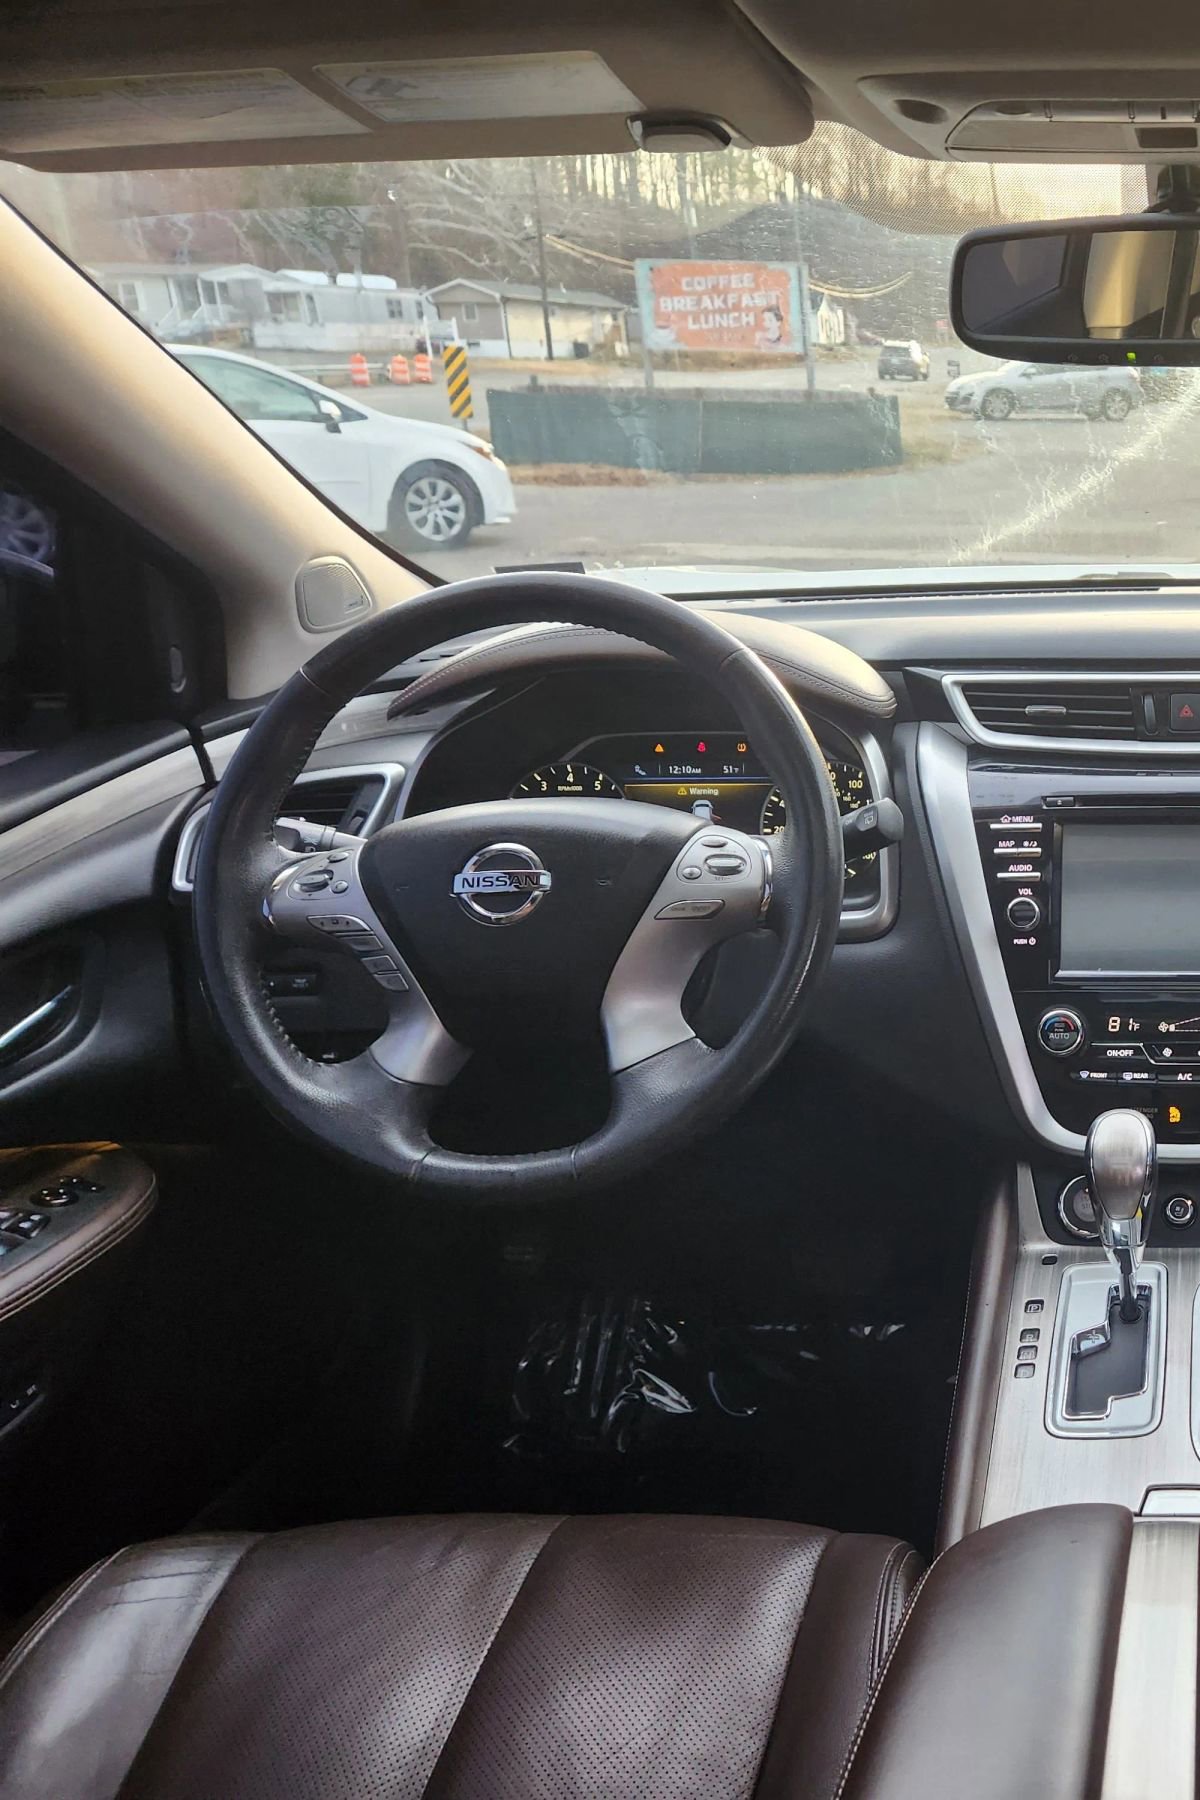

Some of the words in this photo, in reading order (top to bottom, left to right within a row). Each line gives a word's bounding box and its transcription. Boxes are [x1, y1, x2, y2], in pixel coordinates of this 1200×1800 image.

[681, 273, 755, 291] COFFEE
[659, 290, 780, 312] BREAKFAST
[687, 311, 755, 330] LUNCH
[566, 773, 573, 782] 4
[540, 781, 547, 791] 3
[594, 781, 601, 791] 5
[848, 780, 863, 789] 100
[689, 787, 719, 796] Warning
[998, 840, 1015, 848] MAP
[1008, 864, 1033, 872] AUDIO
[462, 875, 539, 889] NISSAN
[1018, 888, 1033, 896] VOL
[1049, 1032, 1070, 1040] AUTO
